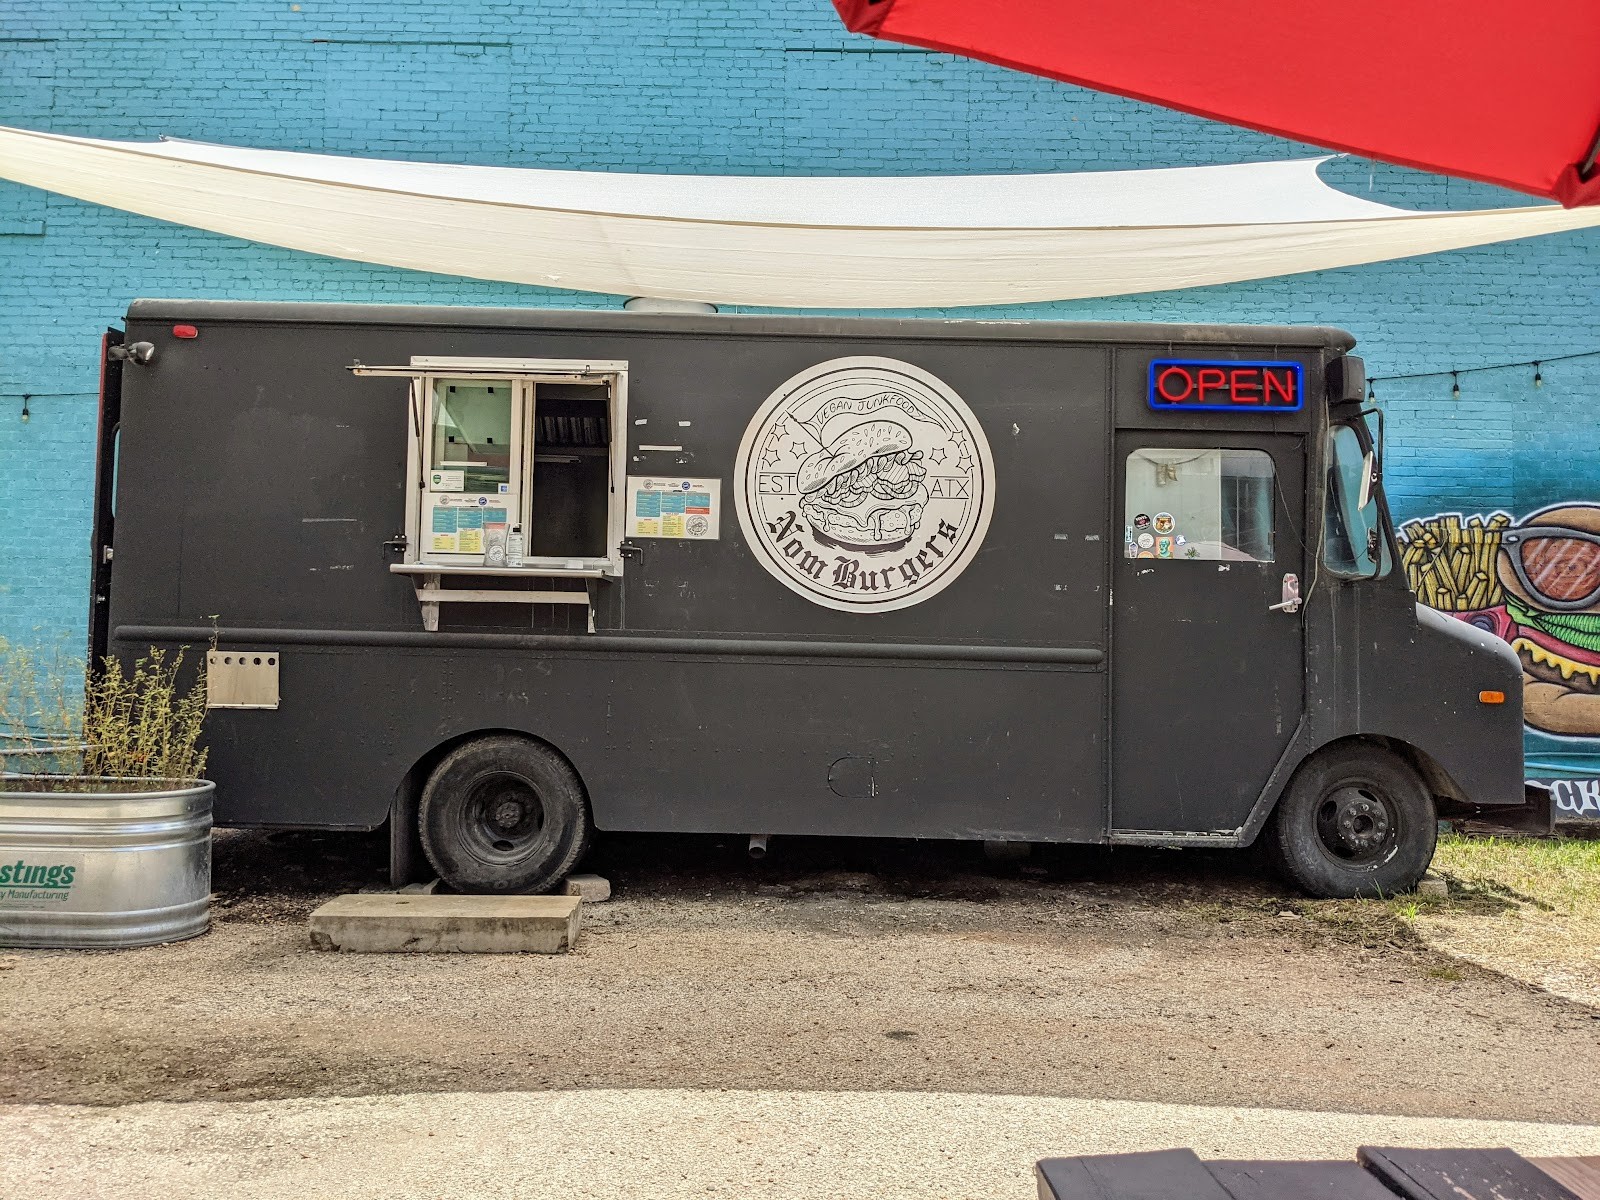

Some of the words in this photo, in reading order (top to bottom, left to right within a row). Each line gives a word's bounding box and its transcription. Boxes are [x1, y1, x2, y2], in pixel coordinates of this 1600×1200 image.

[1158, 367, 1293, 402] OPEN
[817, 401, 852, 424] VEGAN
[758, 474, 795, 493] EST
[930, 478, 970, 498] ATX
[766, 510, 829, 580] Nom
[832, 518, 960, 592] Burgers
[7, 889, 69, 901] Manufacturing
